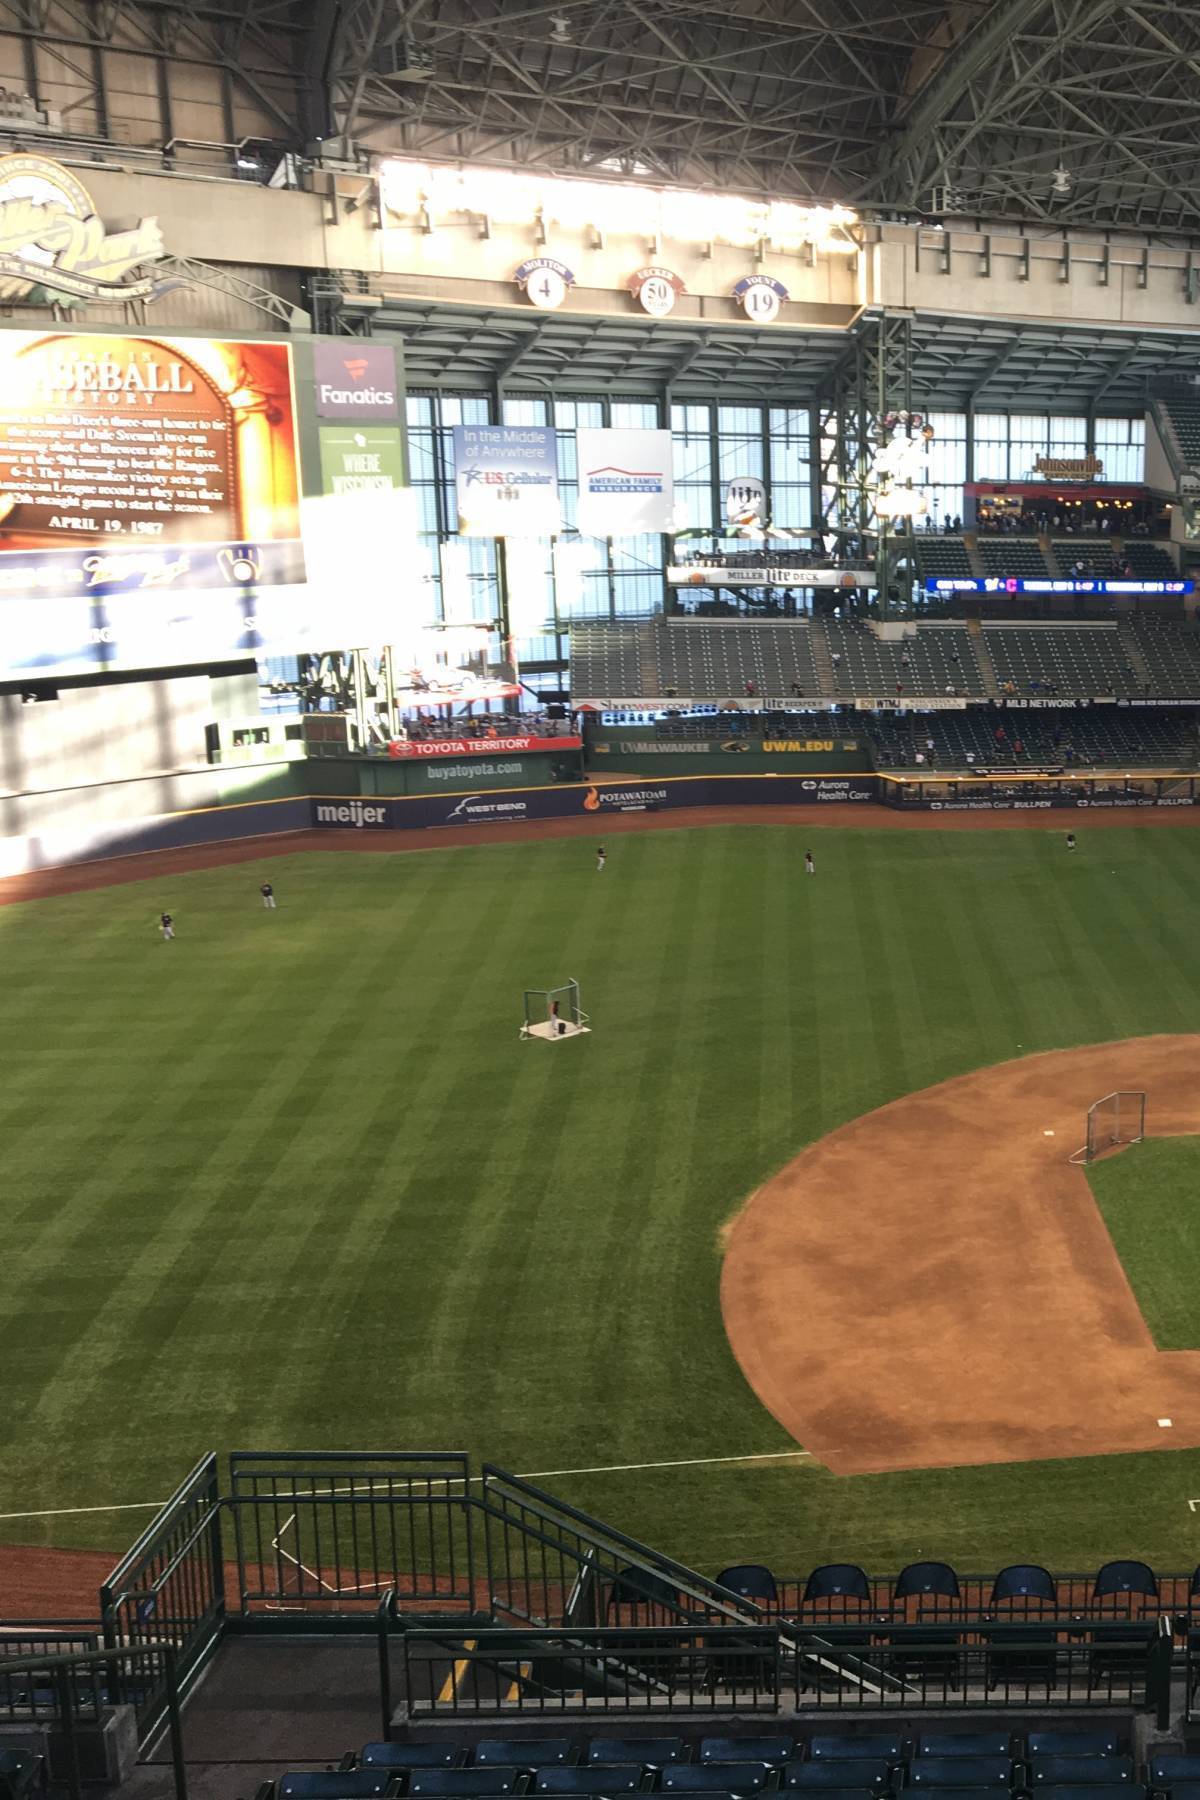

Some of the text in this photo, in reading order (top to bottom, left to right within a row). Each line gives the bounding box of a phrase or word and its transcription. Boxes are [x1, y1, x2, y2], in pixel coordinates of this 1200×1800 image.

[522, 260, 567, 275] MOLITOR
[538, 275, 550, 298] 4
[745, 276, 778, 289] YOUNT
[647, 282, 668, 300] 50
[751, 293, 774, 312] 19
[320, 384, 394, 405] Fanatics
[464, 430, 546, 443] In the Middle
[465, 447, 546, 459] of Anywhere
[342, 453, 382, 473] WHERE
[1032, 452, 1103, 473] Johnsonville
[49, 517, 99, 531] APRIL
[105, 519, 126, 534] 19,
[727, 568, 819, 584] MILLER lite DECK
[876, 699, 901, 708] WTMJ
[1006, 698, 1077, 708] MLB NETWORK
[415, 738, 531, 755] TOYOTA TERRITORY
[762, 741, 833, 752] UWM.EDU
[427, 763, 522, 780] buyatoyota.com
[818, 780, 849, 789] Aurora
[600, 790, 667, 802] POTAWATOMI
[817, 790, 872, 801] Health Care
[1157, 798, 1194, 806] BULLPEN
[466, 802, 526, 813] WEST BEND
[943, 802, 968, 810] Aurora
[968, 801, 993, 809] Health
[1013, 800, 1052, 808] BULLPEN
[317, 801, 386, 828] meijer
